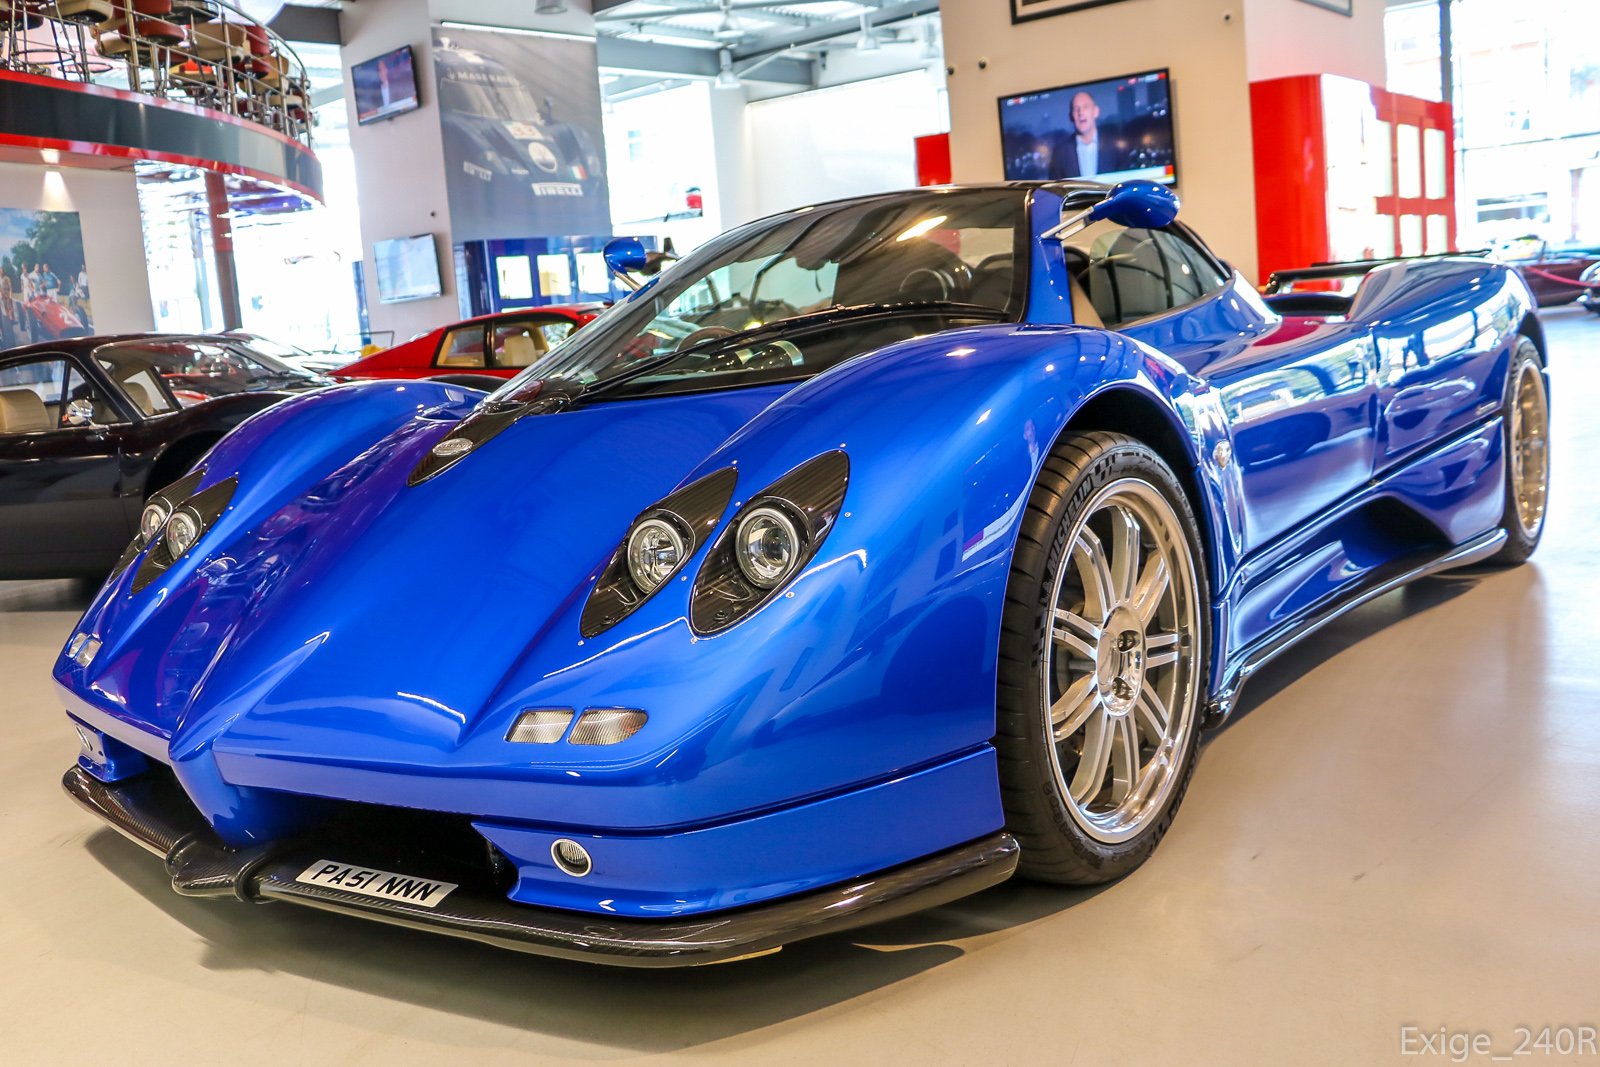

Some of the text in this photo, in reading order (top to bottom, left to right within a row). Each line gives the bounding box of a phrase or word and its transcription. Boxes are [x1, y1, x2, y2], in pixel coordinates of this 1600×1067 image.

[512, 126, 537, 138] 33
[531, 182, 584, 196] PIRELLI
[1047, 474, 1094, 576] MICHELIN
[311, 864, 442, 901] PA51 NNN
